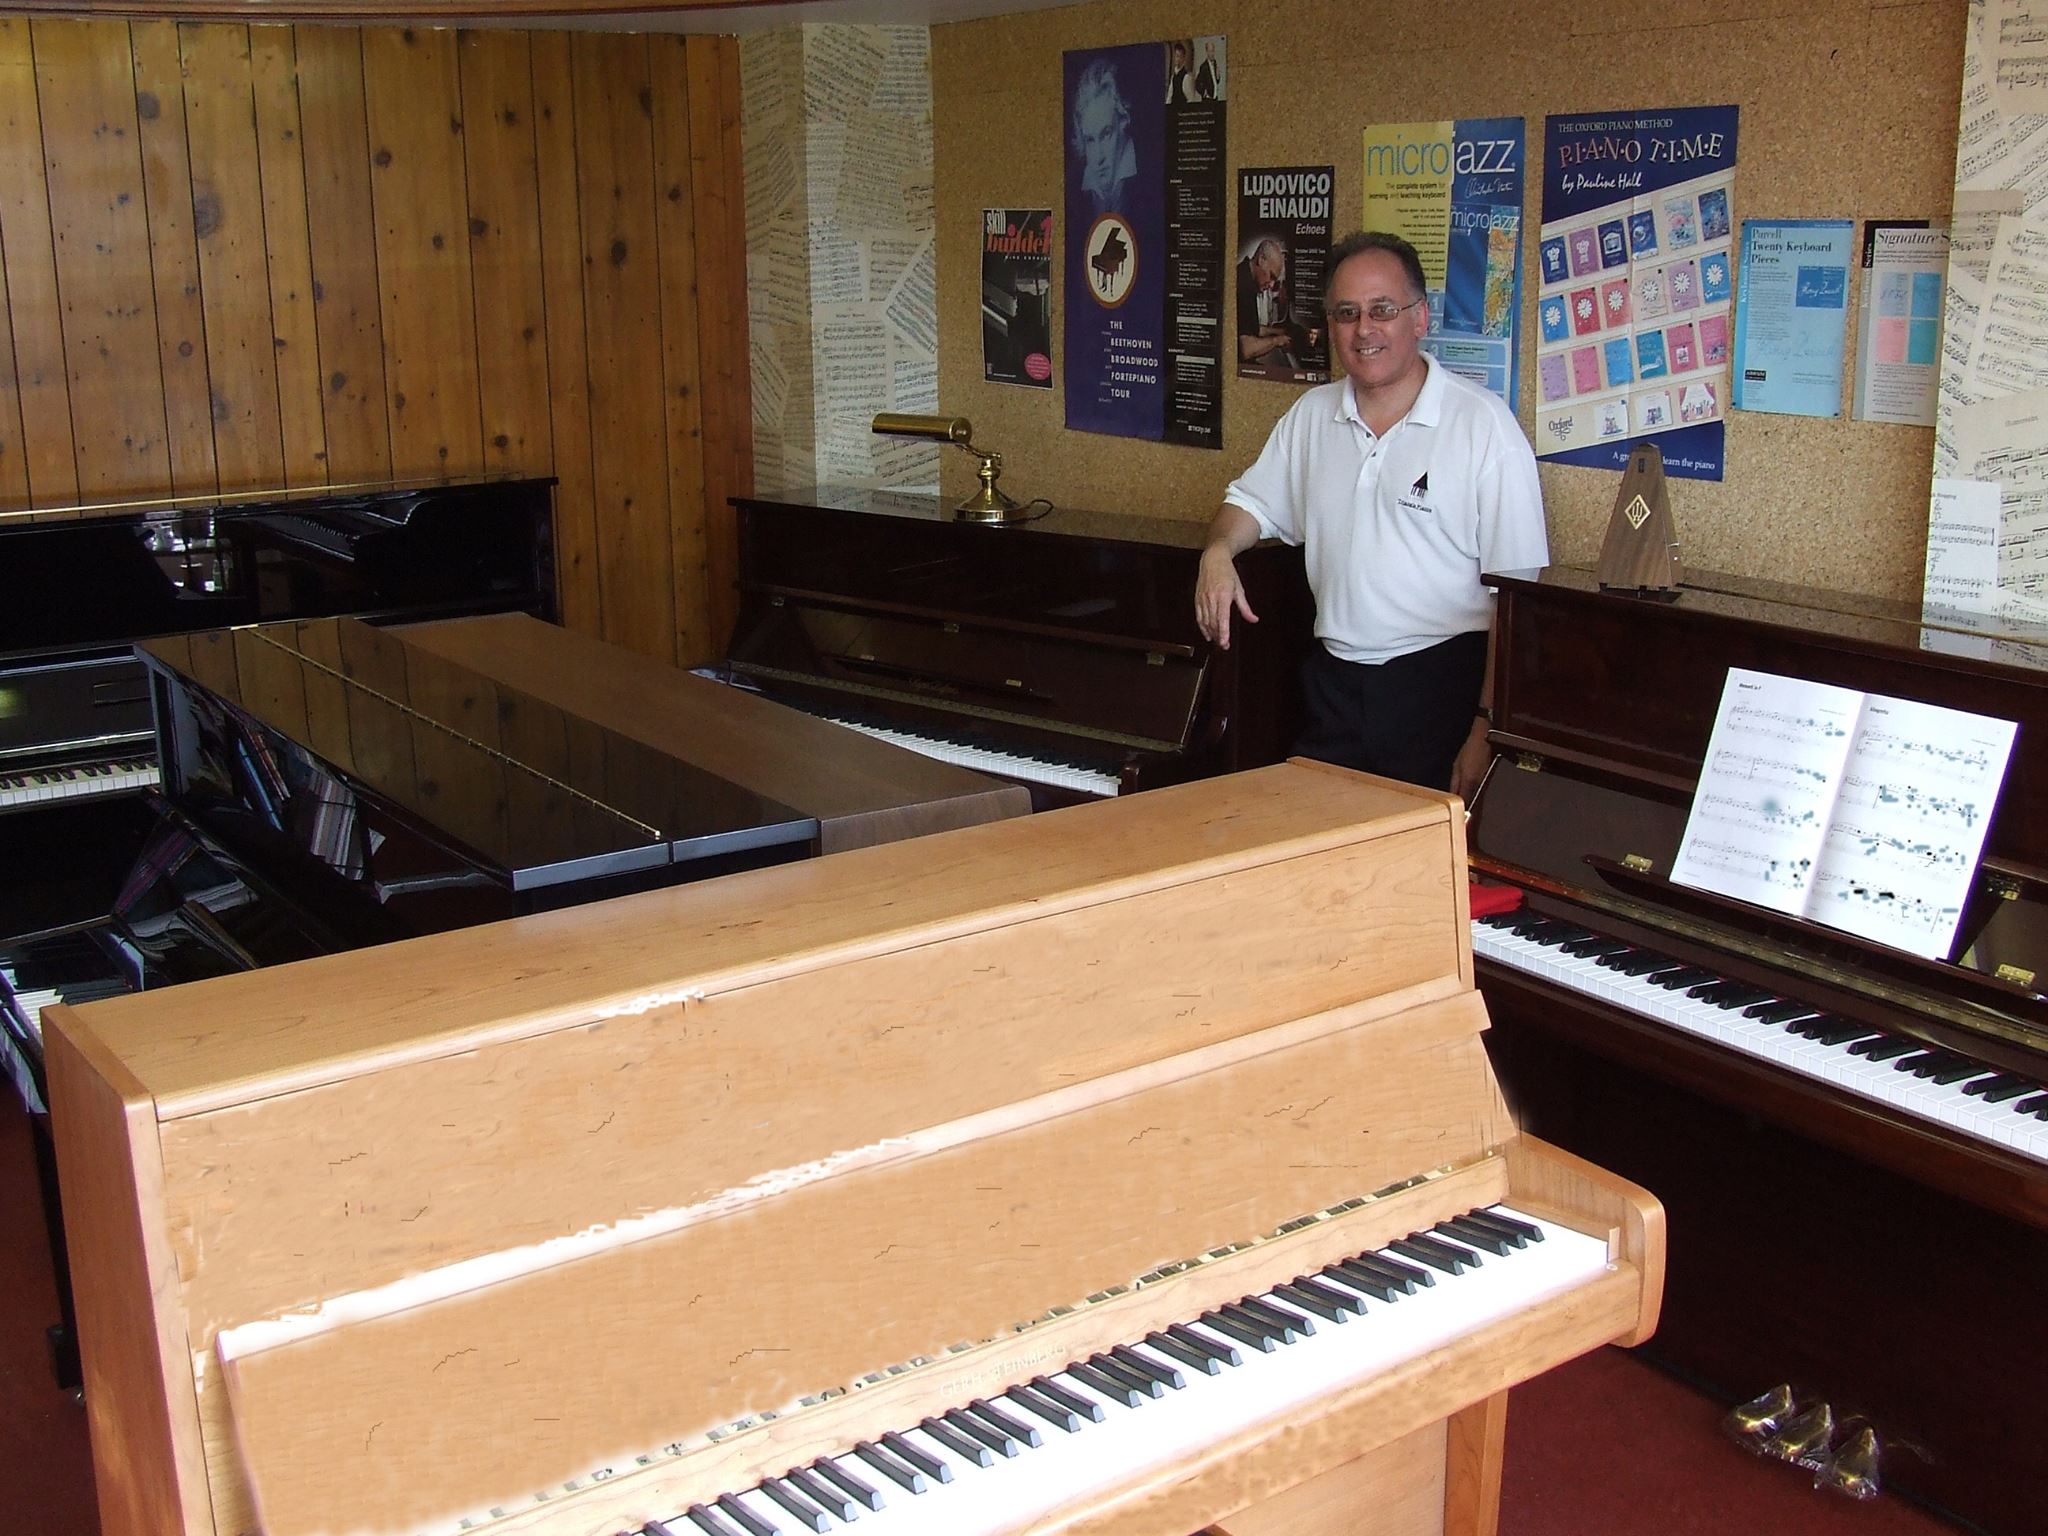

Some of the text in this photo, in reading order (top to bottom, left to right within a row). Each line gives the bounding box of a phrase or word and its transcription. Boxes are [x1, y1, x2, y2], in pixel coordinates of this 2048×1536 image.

[1559, 118, 1673, 132] THE OXFORD PIANO METHOD
[1243, 173, 1331, 196] LUDOVICO
[1562, 172, 1643, 194] by Pauline Hall
[1259, 197, 1330, 219] EINAUDI
[987, 209, 1006, 234] skill
[1295, 223, 1326, 235] Echoes
[1752, 228, 1782, 239] Purcell
[1876, 231, 1938, 249] Signature
[1752, 241, 1832, 254] Twenty Keyboard
[1751, 254, 1780, 264] Pieces
[1863, 243, 1872, 268] Series
[1110, 321, 1122, 330] THE
[1110, 338, 1152, 349] BEETHOVEN
[1111, 355, 1158, 367] BROADWOOD
[1111, 371, 1157, 384] FORTEPIANO
[1111, 388, 1130, 398] TOUR
[1612, 451, 1619, 459] A
[1662, 456, 1681, 467] learn
[1682, 459, 1693, 467] the
[1694, 460, 1716, 471] piano
